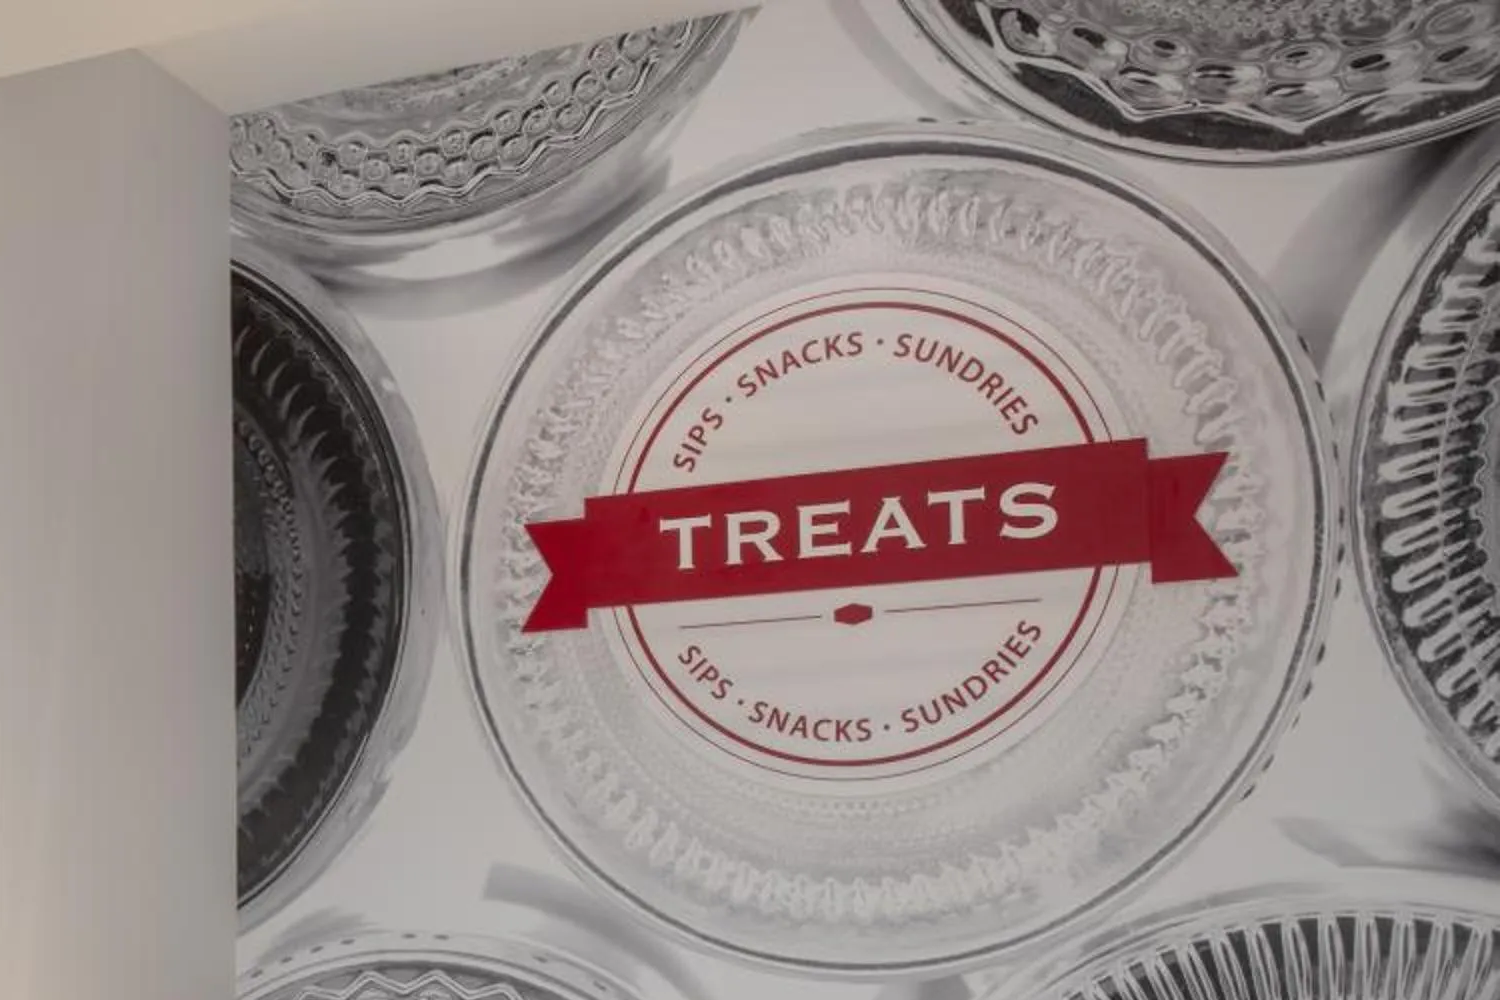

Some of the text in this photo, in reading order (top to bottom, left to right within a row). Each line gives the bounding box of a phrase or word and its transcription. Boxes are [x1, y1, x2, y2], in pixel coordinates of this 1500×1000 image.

[672, 331, 1040, 473] SIPS SNACKS SUNDRIES
[660, 482, 1059, 571] TREATS
[678, 618, 1043, 743] SIPS SNACKS SUNDRIES
